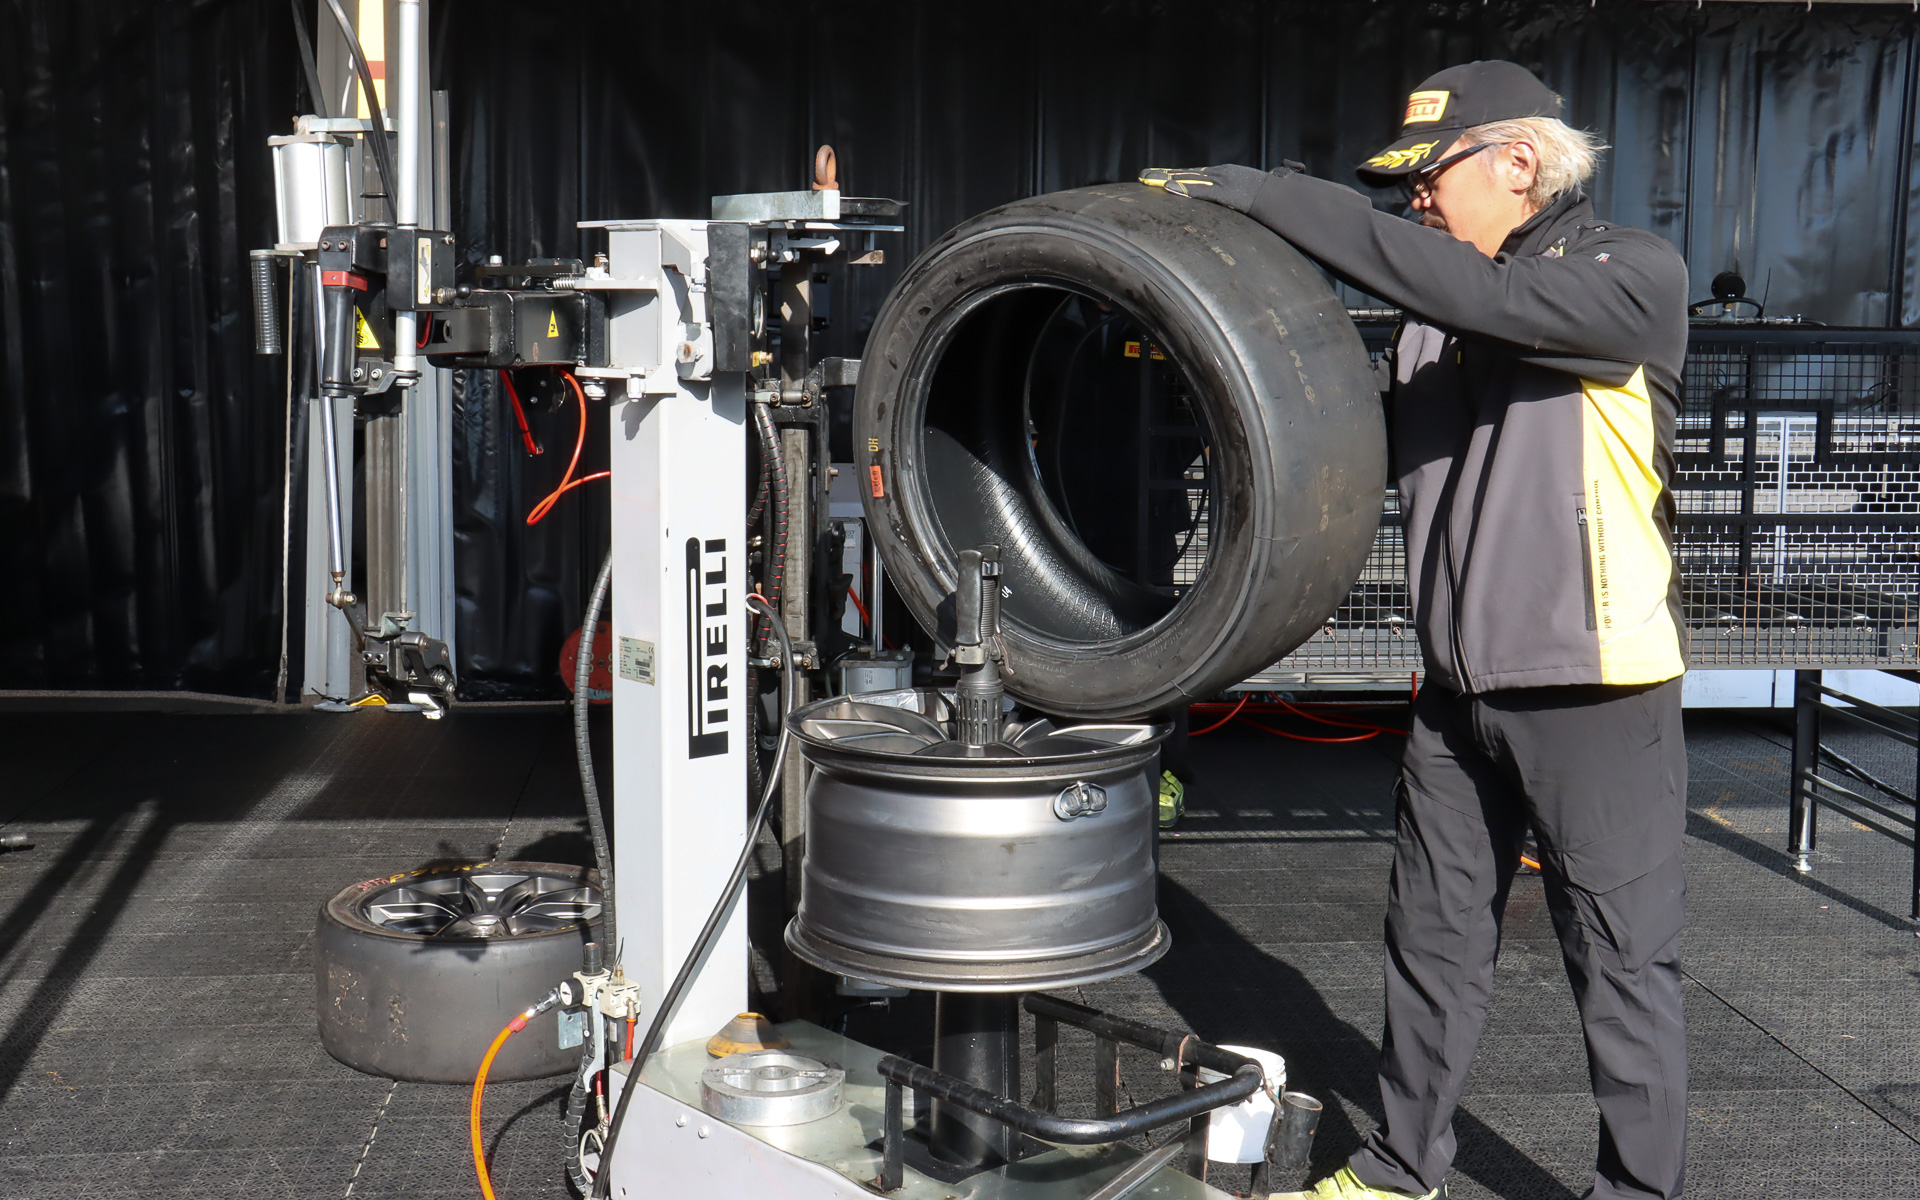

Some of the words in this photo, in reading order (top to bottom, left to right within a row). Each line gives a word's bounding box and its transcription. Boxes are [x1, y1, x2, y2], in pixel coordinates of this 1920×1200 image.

[868, 437, 879, 452] DH
[1594, 479, 1602, 515] CONTROL
[1597, 518, 1605, 552] WITHOUT
[1599, 554, 1608, 589] NOTHING
[1601, 591, 1609, 599] IS
[685, 536, 729, 759] PIRELLI
